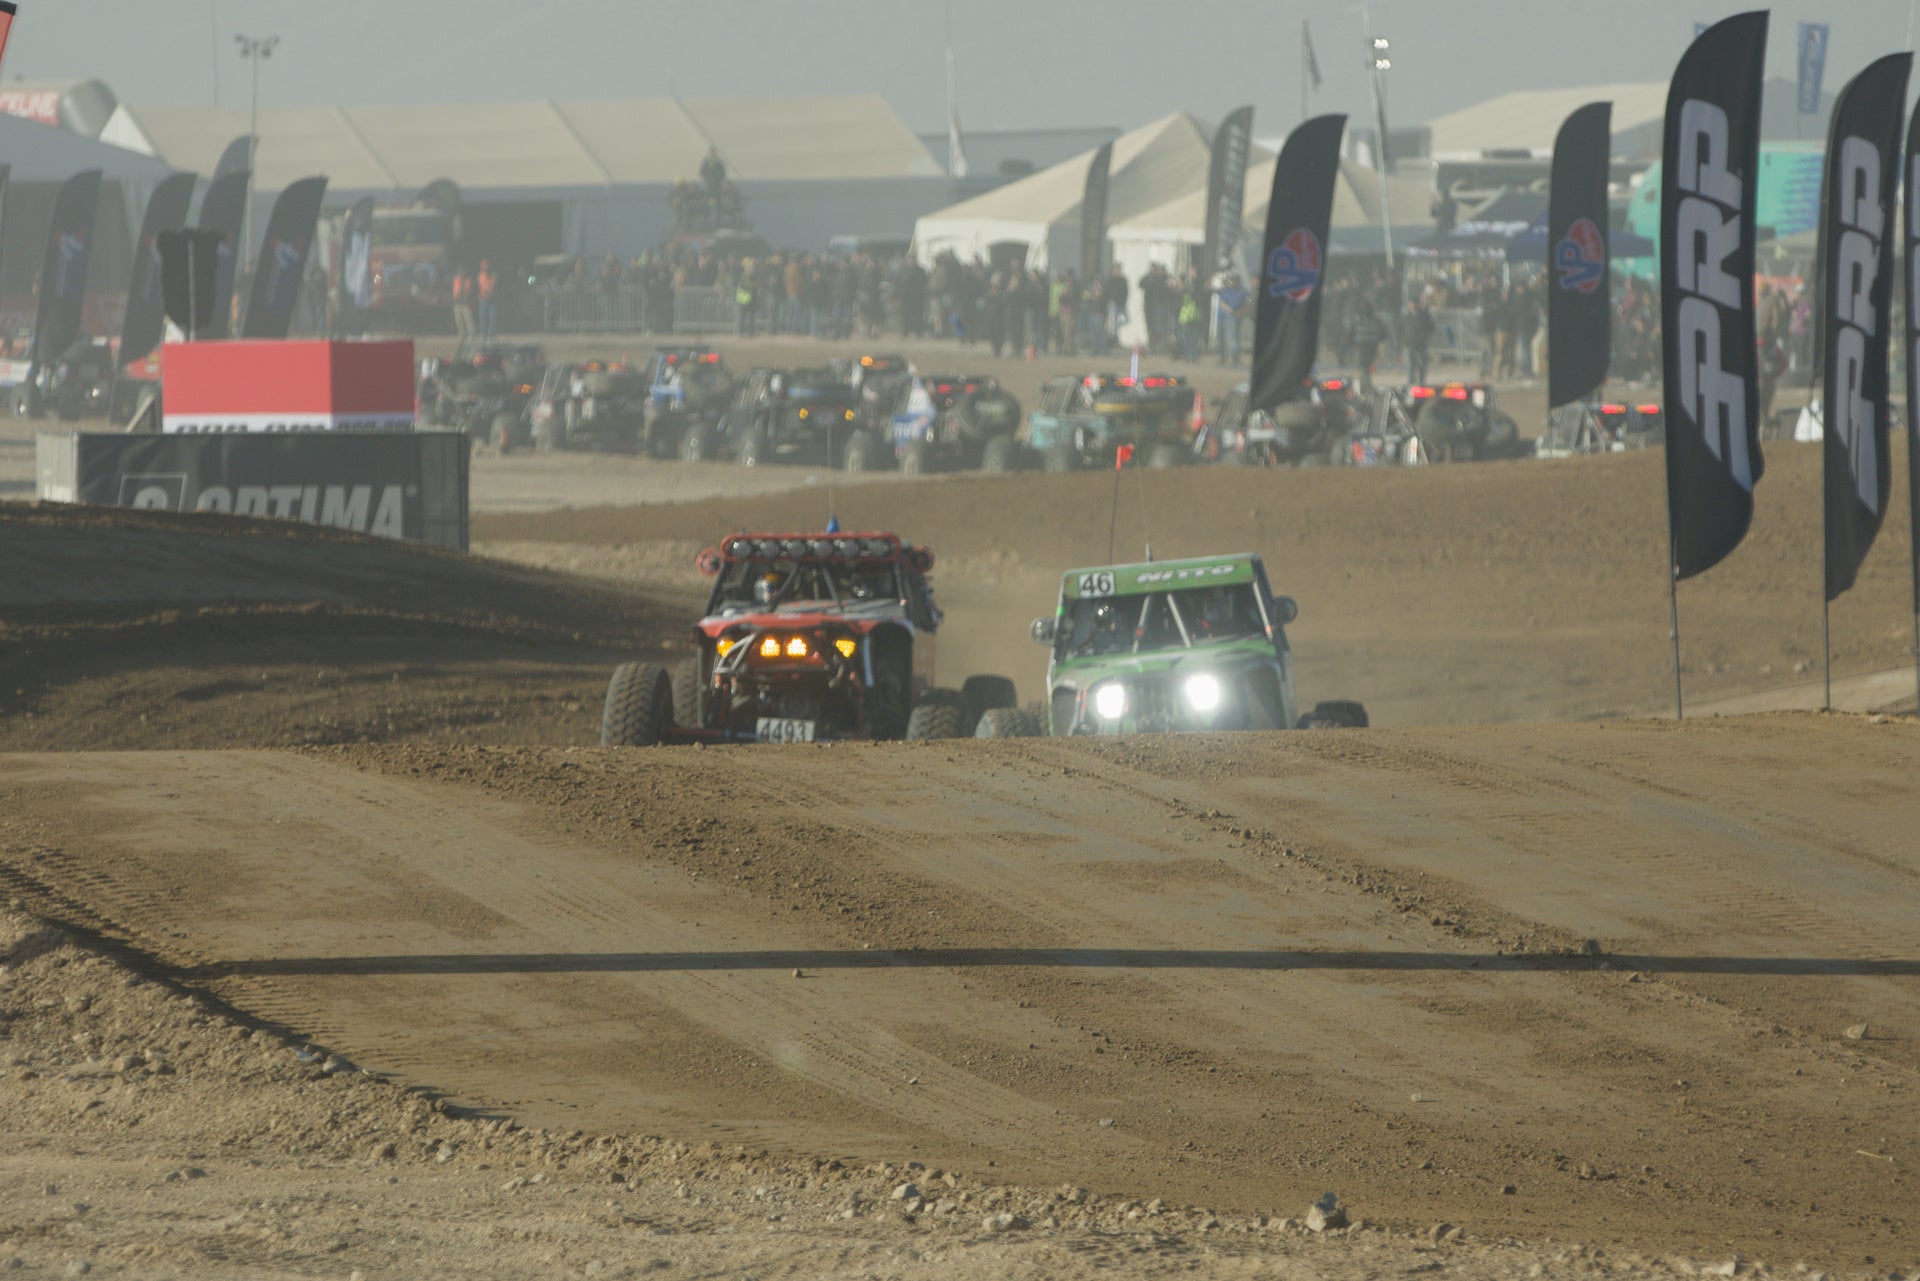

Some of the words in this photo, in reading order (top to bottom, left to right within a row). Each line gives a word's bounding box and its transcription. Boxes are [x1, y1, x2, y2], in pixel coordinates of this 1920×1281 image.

[1269, 246, 1317, 297] VP
[1557, 239, 1601, 289] VP
[1677, 98, 1752, 493] PRP
[1082, 573, 1111, 594] 46
[1136, 564, 1235, 583] NITTO
